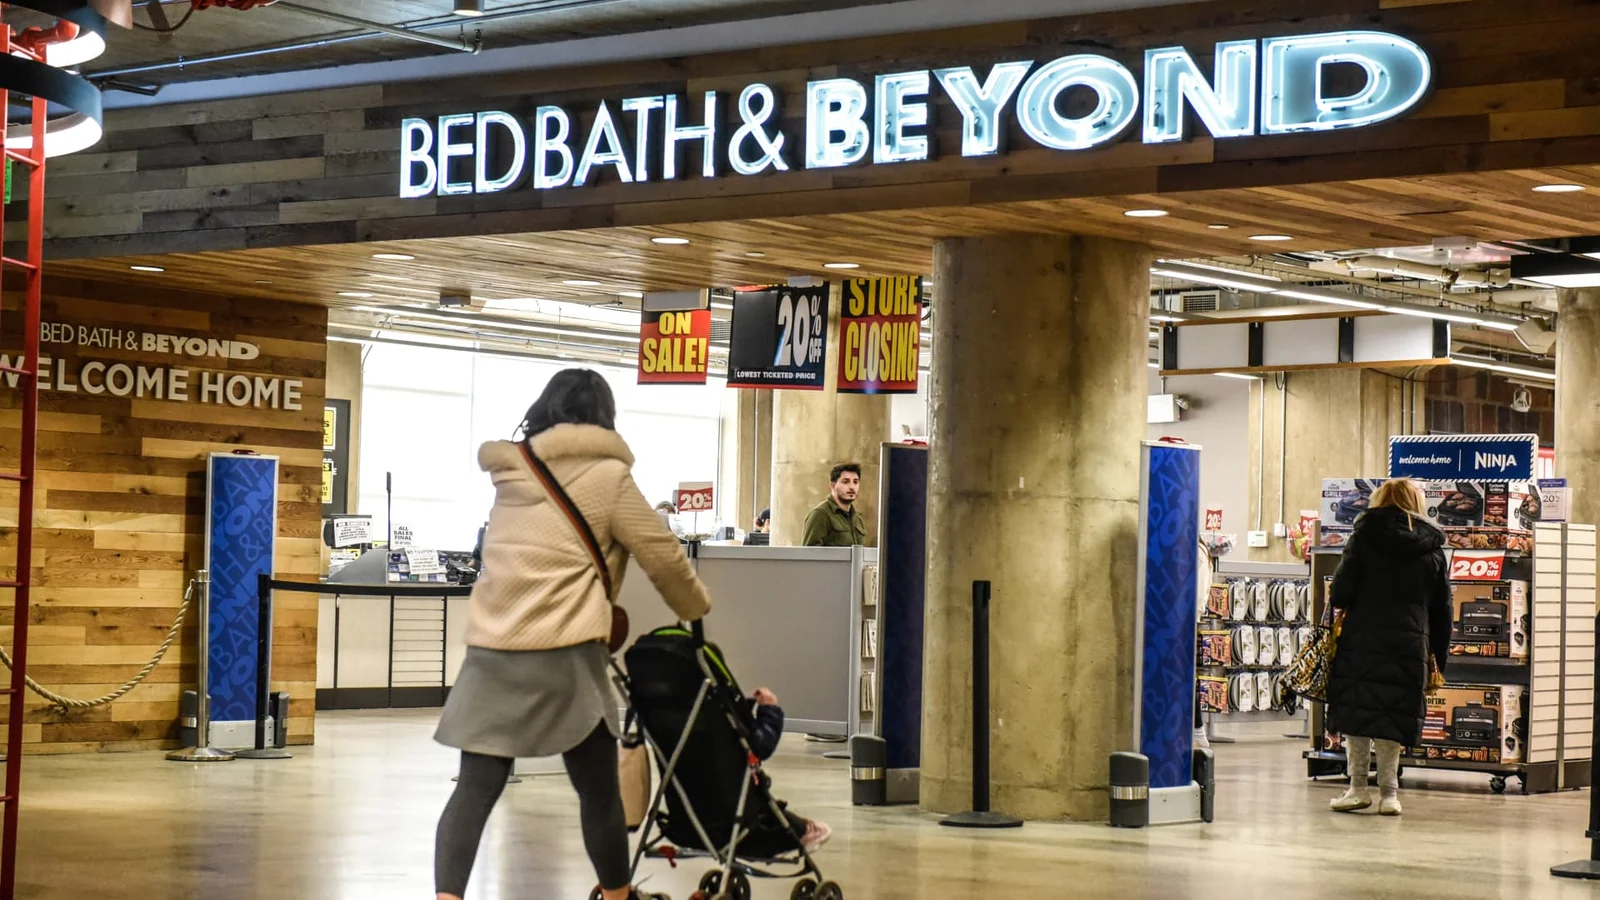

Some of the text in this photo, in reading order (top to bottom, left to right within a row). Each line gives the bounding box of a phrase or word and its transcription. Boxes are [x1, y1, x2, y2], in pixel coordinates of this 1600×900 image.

[399, 30, 1431, 198] BED BATH & BEYOND
[849, 275, 918, 316] STORE
[40, 322, 260, 360] BED BATH & BEYOND
[658, 312, 691, 335] ON
[642, 338, 707, 373] SALE!
[808, 338, 822, 363] OFF
[844, 321, 918, 382] CLOSING
[201, 371, 303, 411] HOME
[763, 371, 794, 379] TICKETED
[795, 372, 816, 380] PRICE
[1399, 451, 1517, 473] welcome home NINJA
[1452, 560, 1499, 577] 20%
